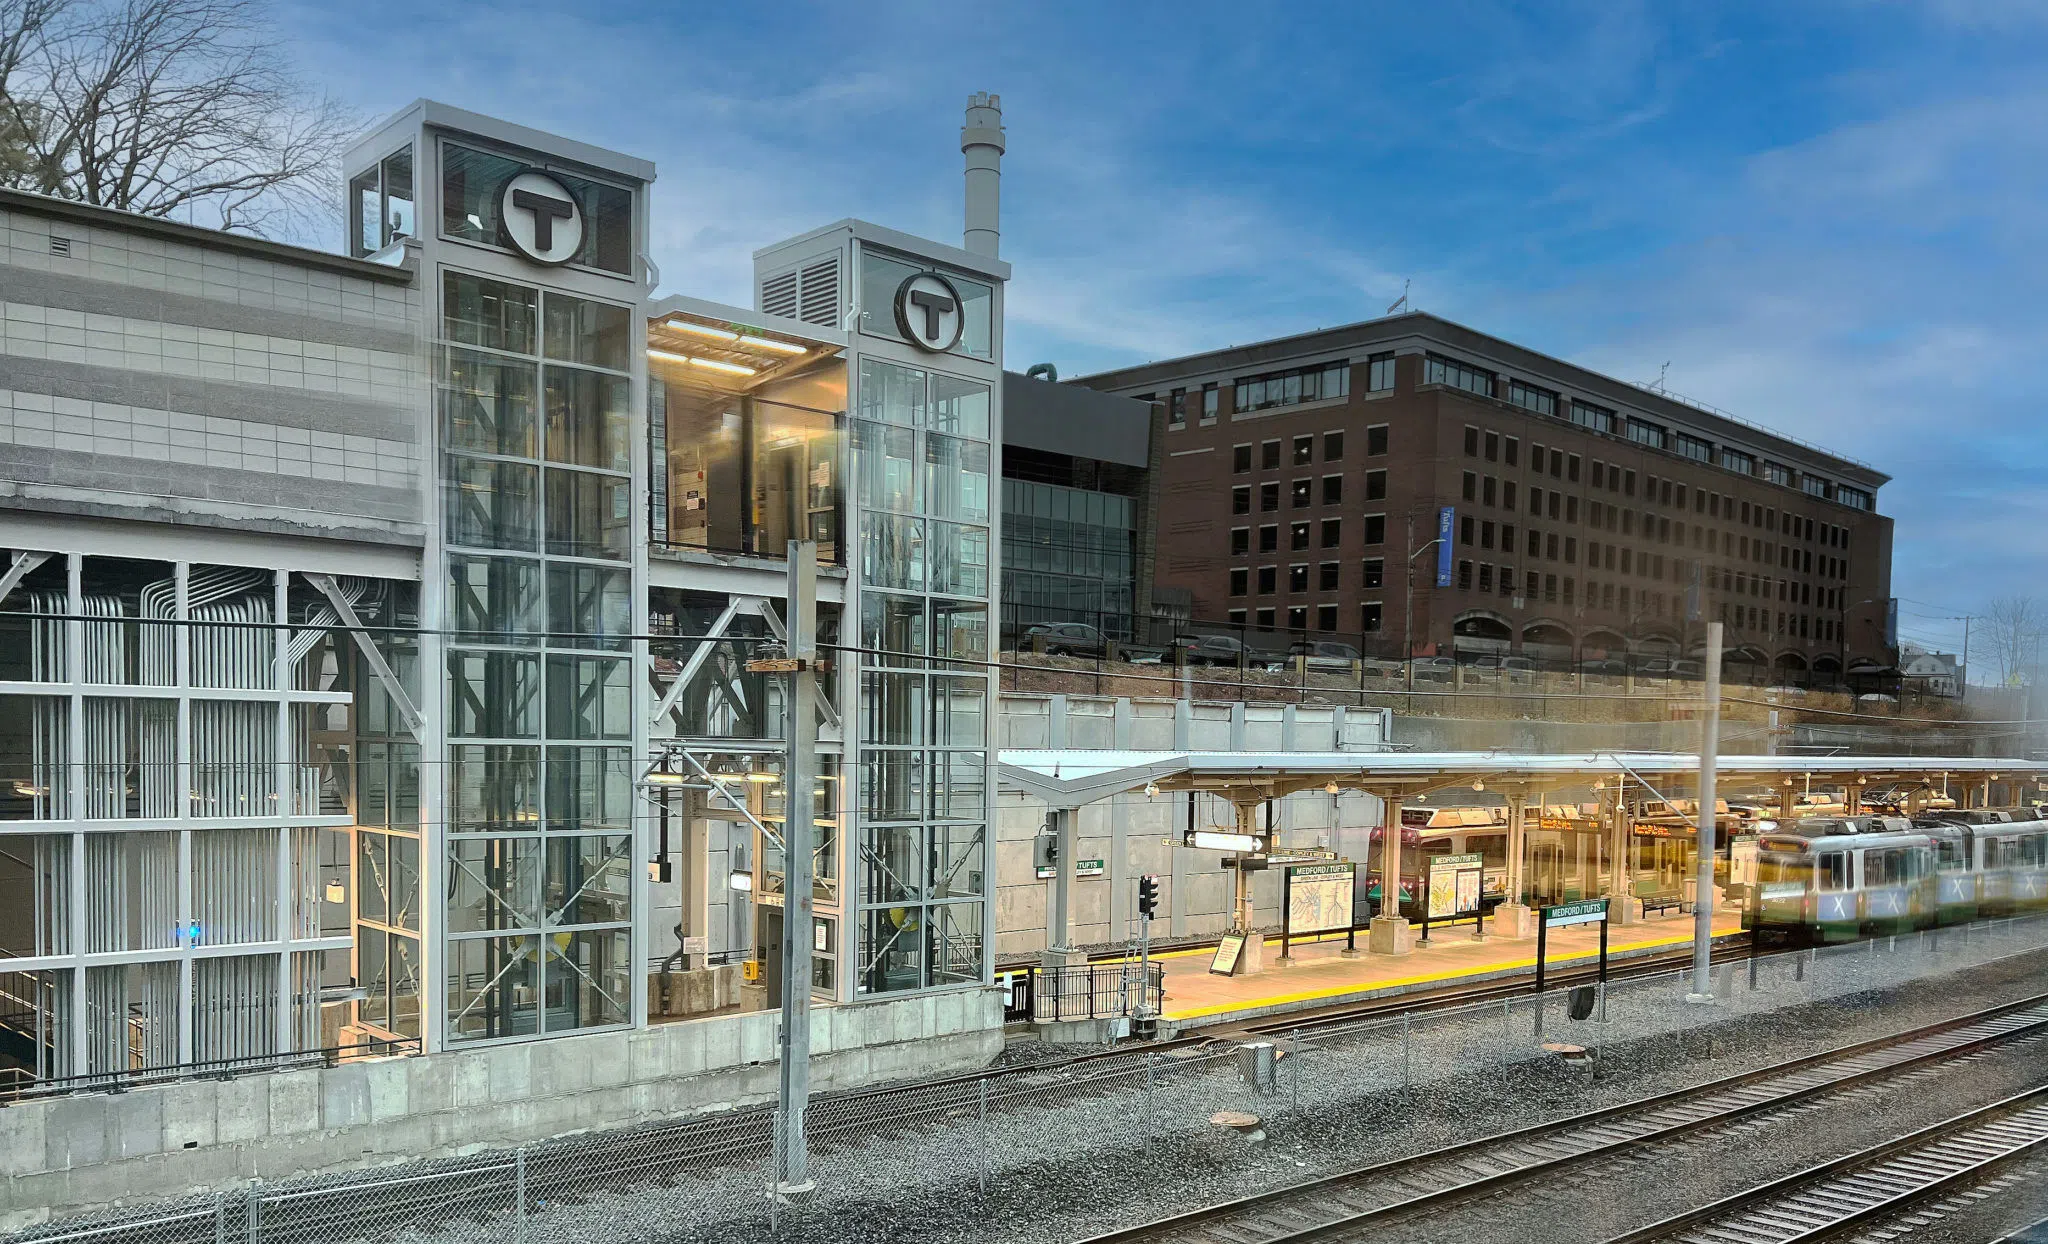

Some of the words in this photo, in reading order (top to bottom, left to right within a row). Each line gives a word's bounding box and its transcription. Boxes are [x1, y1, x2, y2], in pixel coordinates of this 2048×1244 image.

[513, 188, 573, 251] T
[911, 290, 953, 340] T
[1296, 864, 1348, 875] MEDFORD/TUFTS
[1551, 903, 1601, 917] MEDFORD/TUFTS
